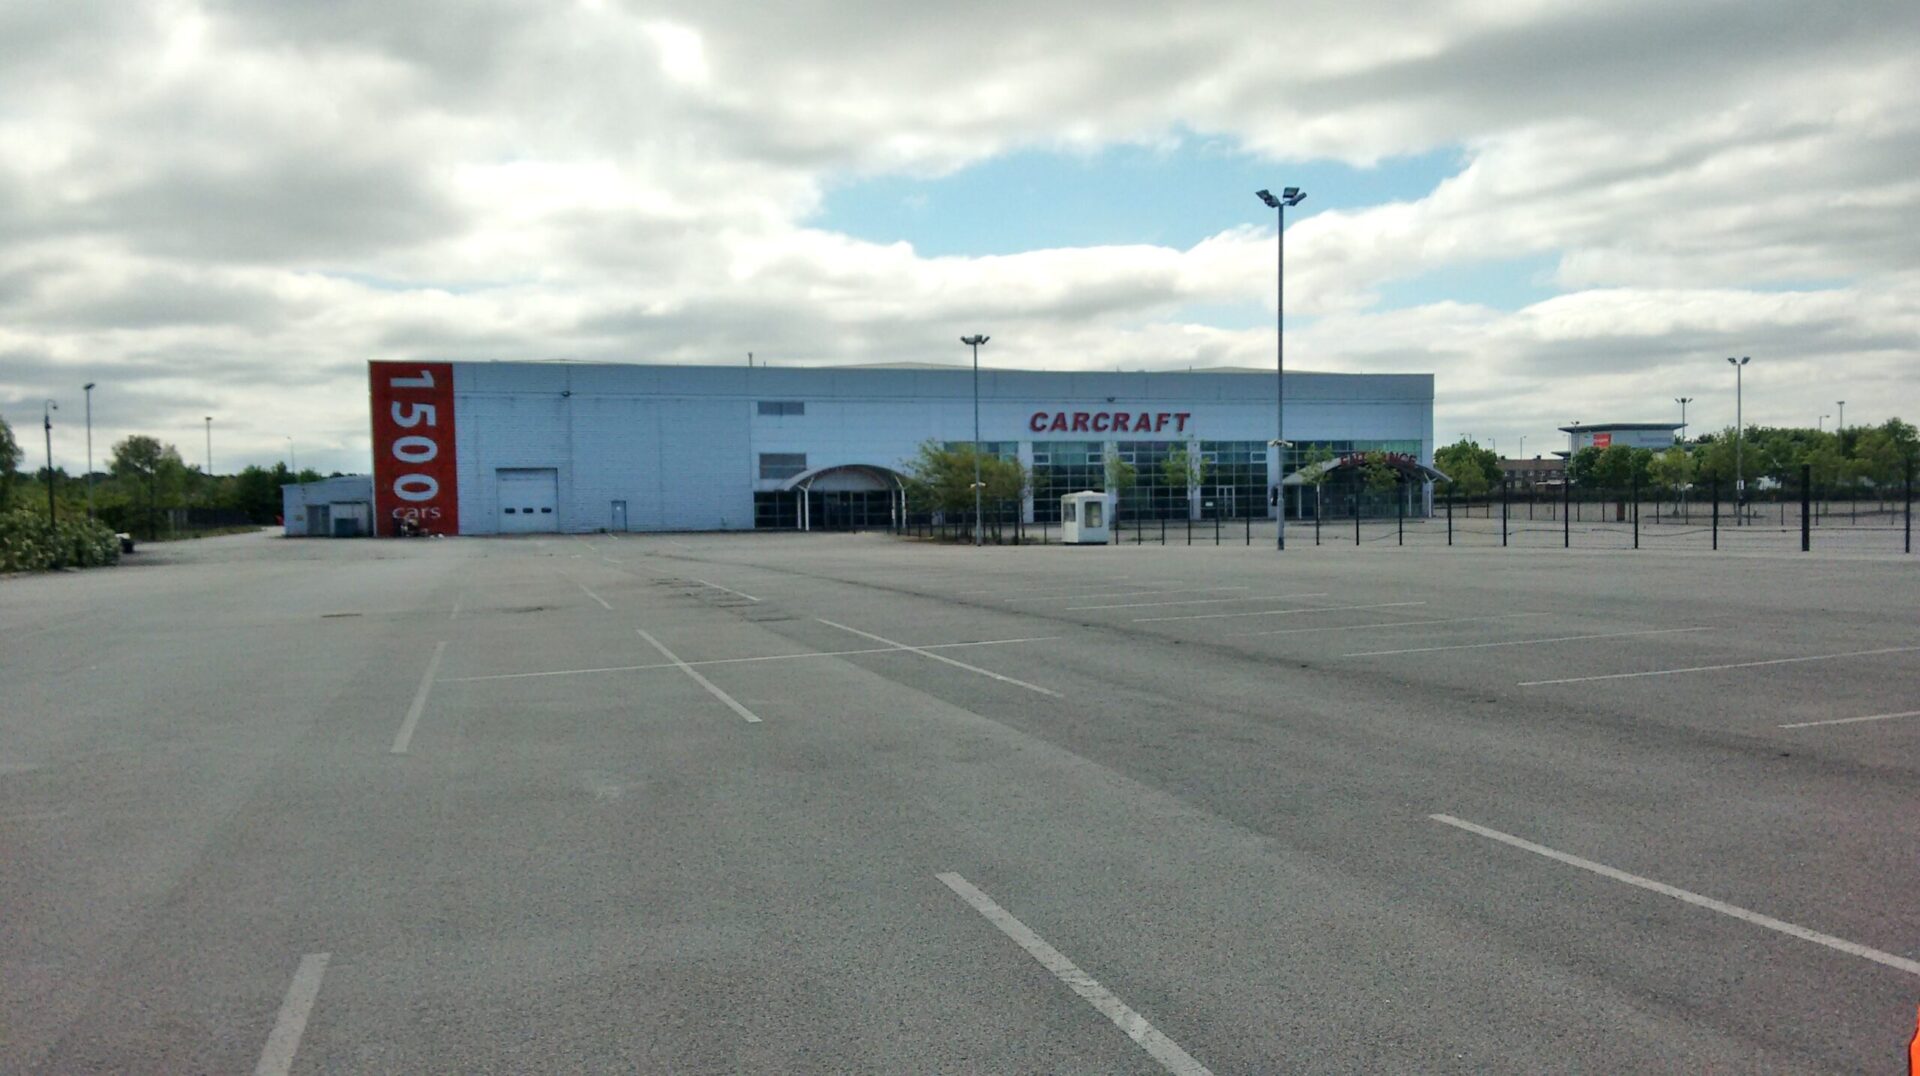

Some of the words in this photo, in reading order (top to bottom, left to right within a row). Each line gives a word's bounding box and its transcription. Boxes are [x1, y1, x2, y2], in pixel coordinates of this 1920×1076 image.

[1030, 412, 1191, 432] CARCRAFT
[390, 370, 439, 501] 1500
[392, 507, 441, 519] cars
